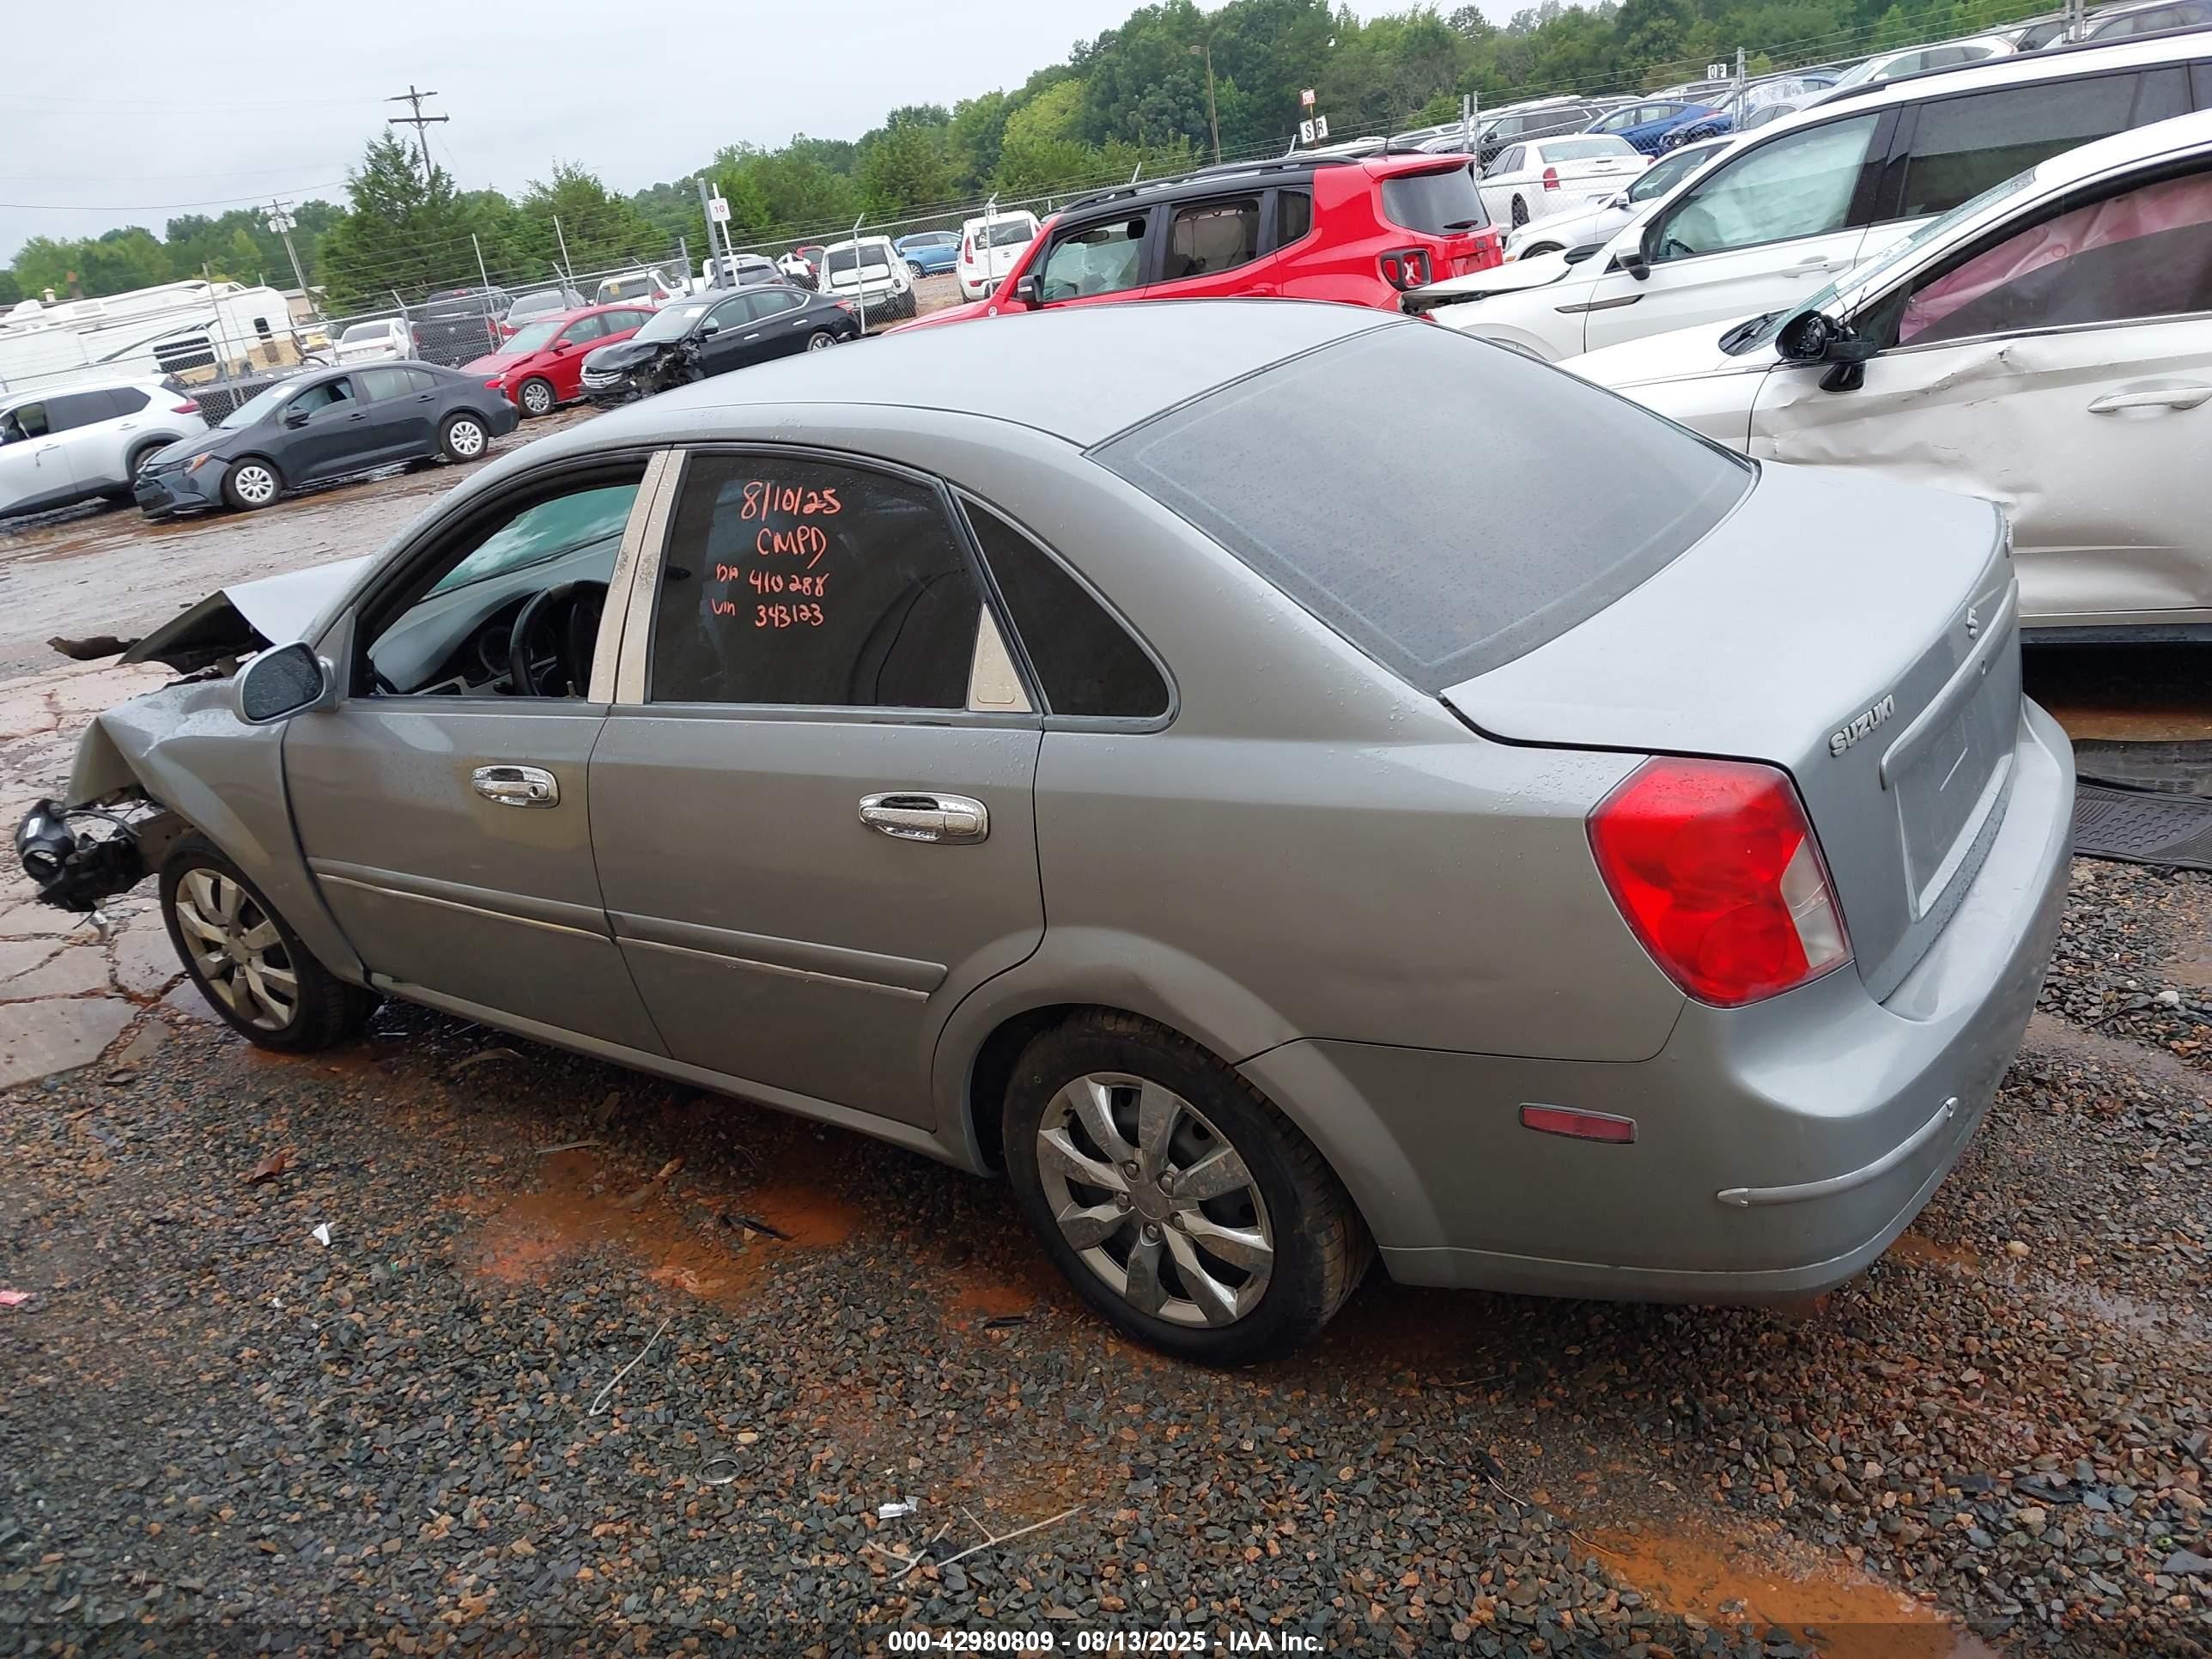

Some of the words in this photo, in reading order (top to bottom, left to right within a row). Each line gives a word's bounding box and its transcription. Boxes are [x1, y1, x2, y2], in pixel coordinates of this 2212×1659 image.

[1304, 124, 1312, 139] S
[1316, 120, 1324, 136] R
[714, 205, 725, 214] 10
[740, 481, 842, 522] 8/10/25
[757, 525, 827, 569] CMPD
[755, 603, 824, 628] 343123
[1829, 694, 1896, 757] SUZUKI
